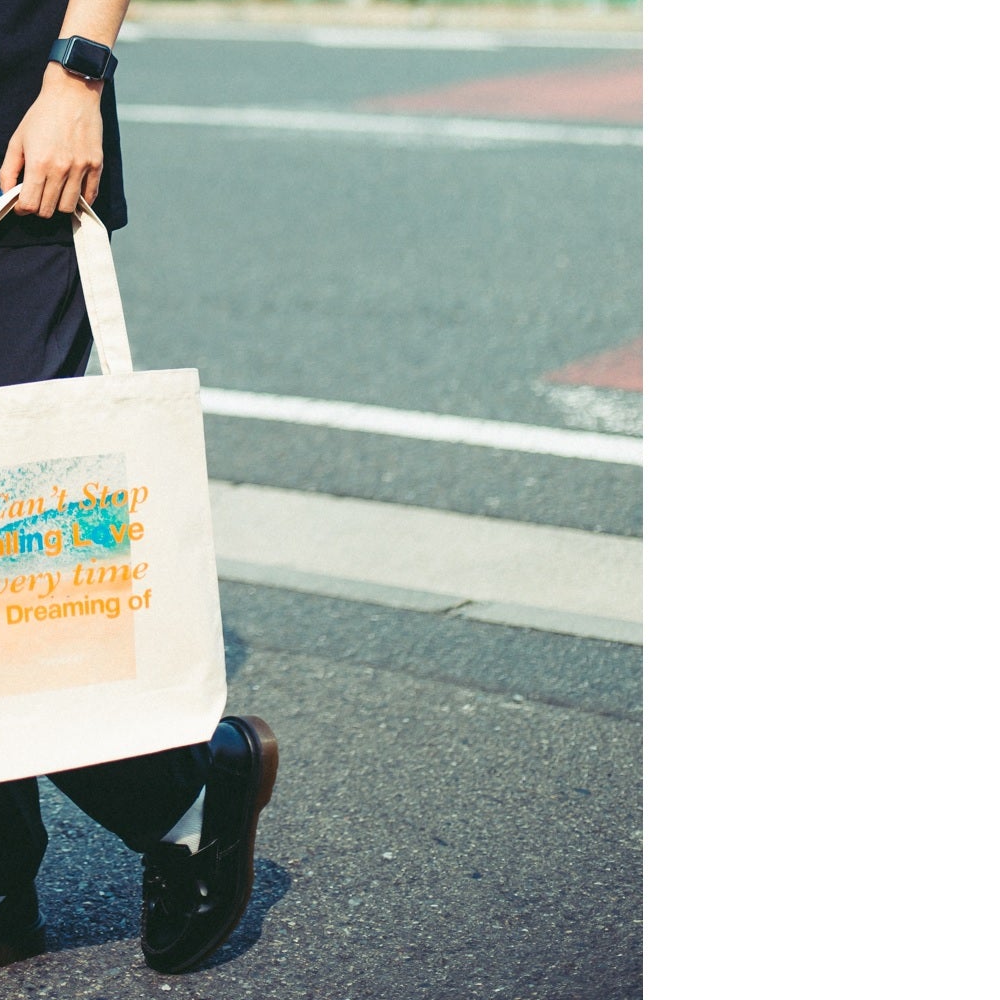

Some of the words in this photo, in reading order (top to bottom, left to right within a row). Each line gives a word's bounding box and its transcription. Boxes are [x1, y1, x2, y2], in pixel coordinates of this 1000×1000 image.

[81, 481, 149, 513] Stop
[73, 557, 149, 586] time
[6, 594, 121, 625] Dreaming
[127, 588, 152, 610] of
